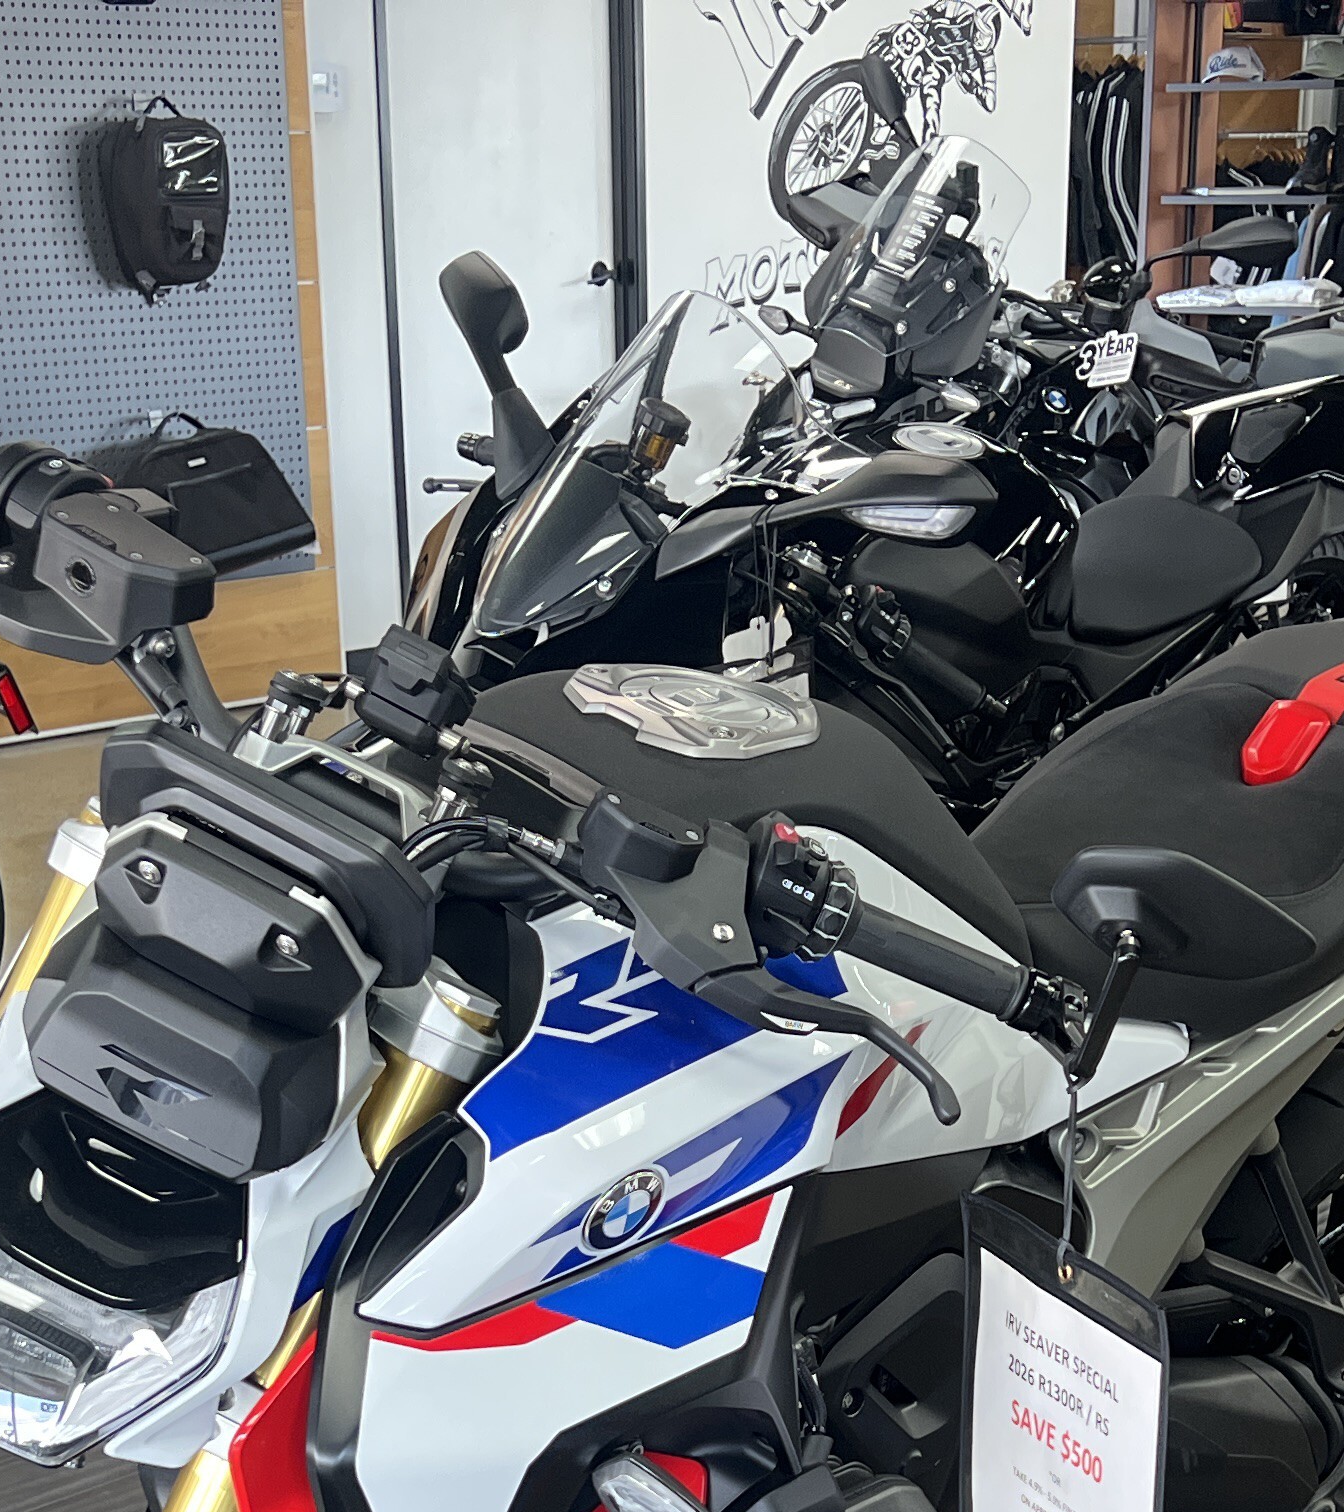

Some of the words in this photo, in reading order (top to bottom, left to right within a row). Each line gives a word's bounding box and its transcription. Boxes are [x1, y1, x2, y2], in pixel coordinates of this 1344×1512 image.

[1078, 343, 1097, 376] 3
[1097, 336, 1135, 359] YEAR
[599, 1177, 660, 1214] BMW
[1006, 1310, 1021, 1337] IRV
[1023, 1326, 1070, 1370] SEAVER
[1073, 1355, 1119, 1404] SPECIAL
[1008, 1353, 1035, 1386] 2026
[1038, 1373, 1084, 1419] R1300R
[1095, 1411, 1109, 1436] RS
[1011, 1399, 1056, 1451] SAVE
[1061, 1429, 1103, 1484] $500
[1013, 1466, 1028, 1485] TAKE
[1021, 1494, 1031, 1509] ON
